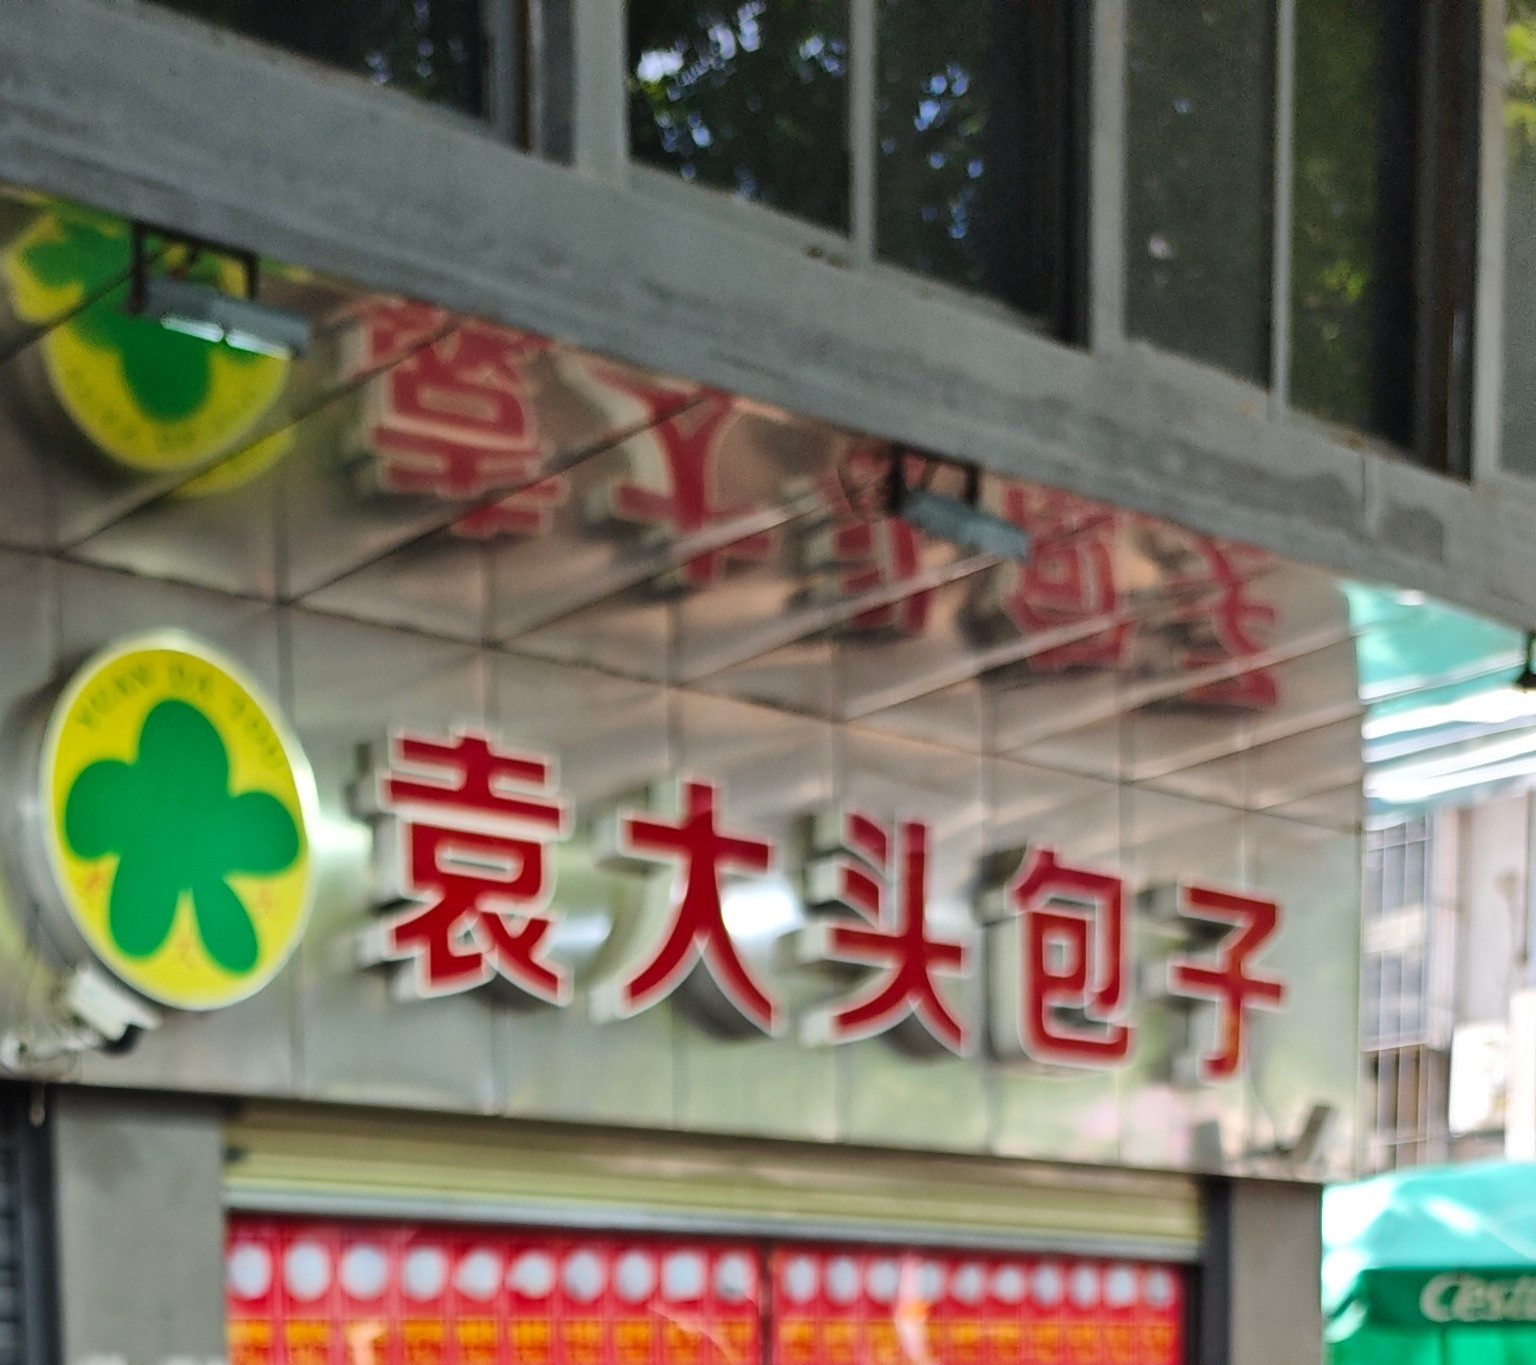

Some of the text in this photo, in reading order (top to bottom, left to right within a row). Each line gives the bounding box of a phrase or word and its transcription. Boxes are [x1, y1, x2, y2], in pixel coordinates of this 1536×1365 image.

[374, 724, 1290, 1082] 袁大头包子
